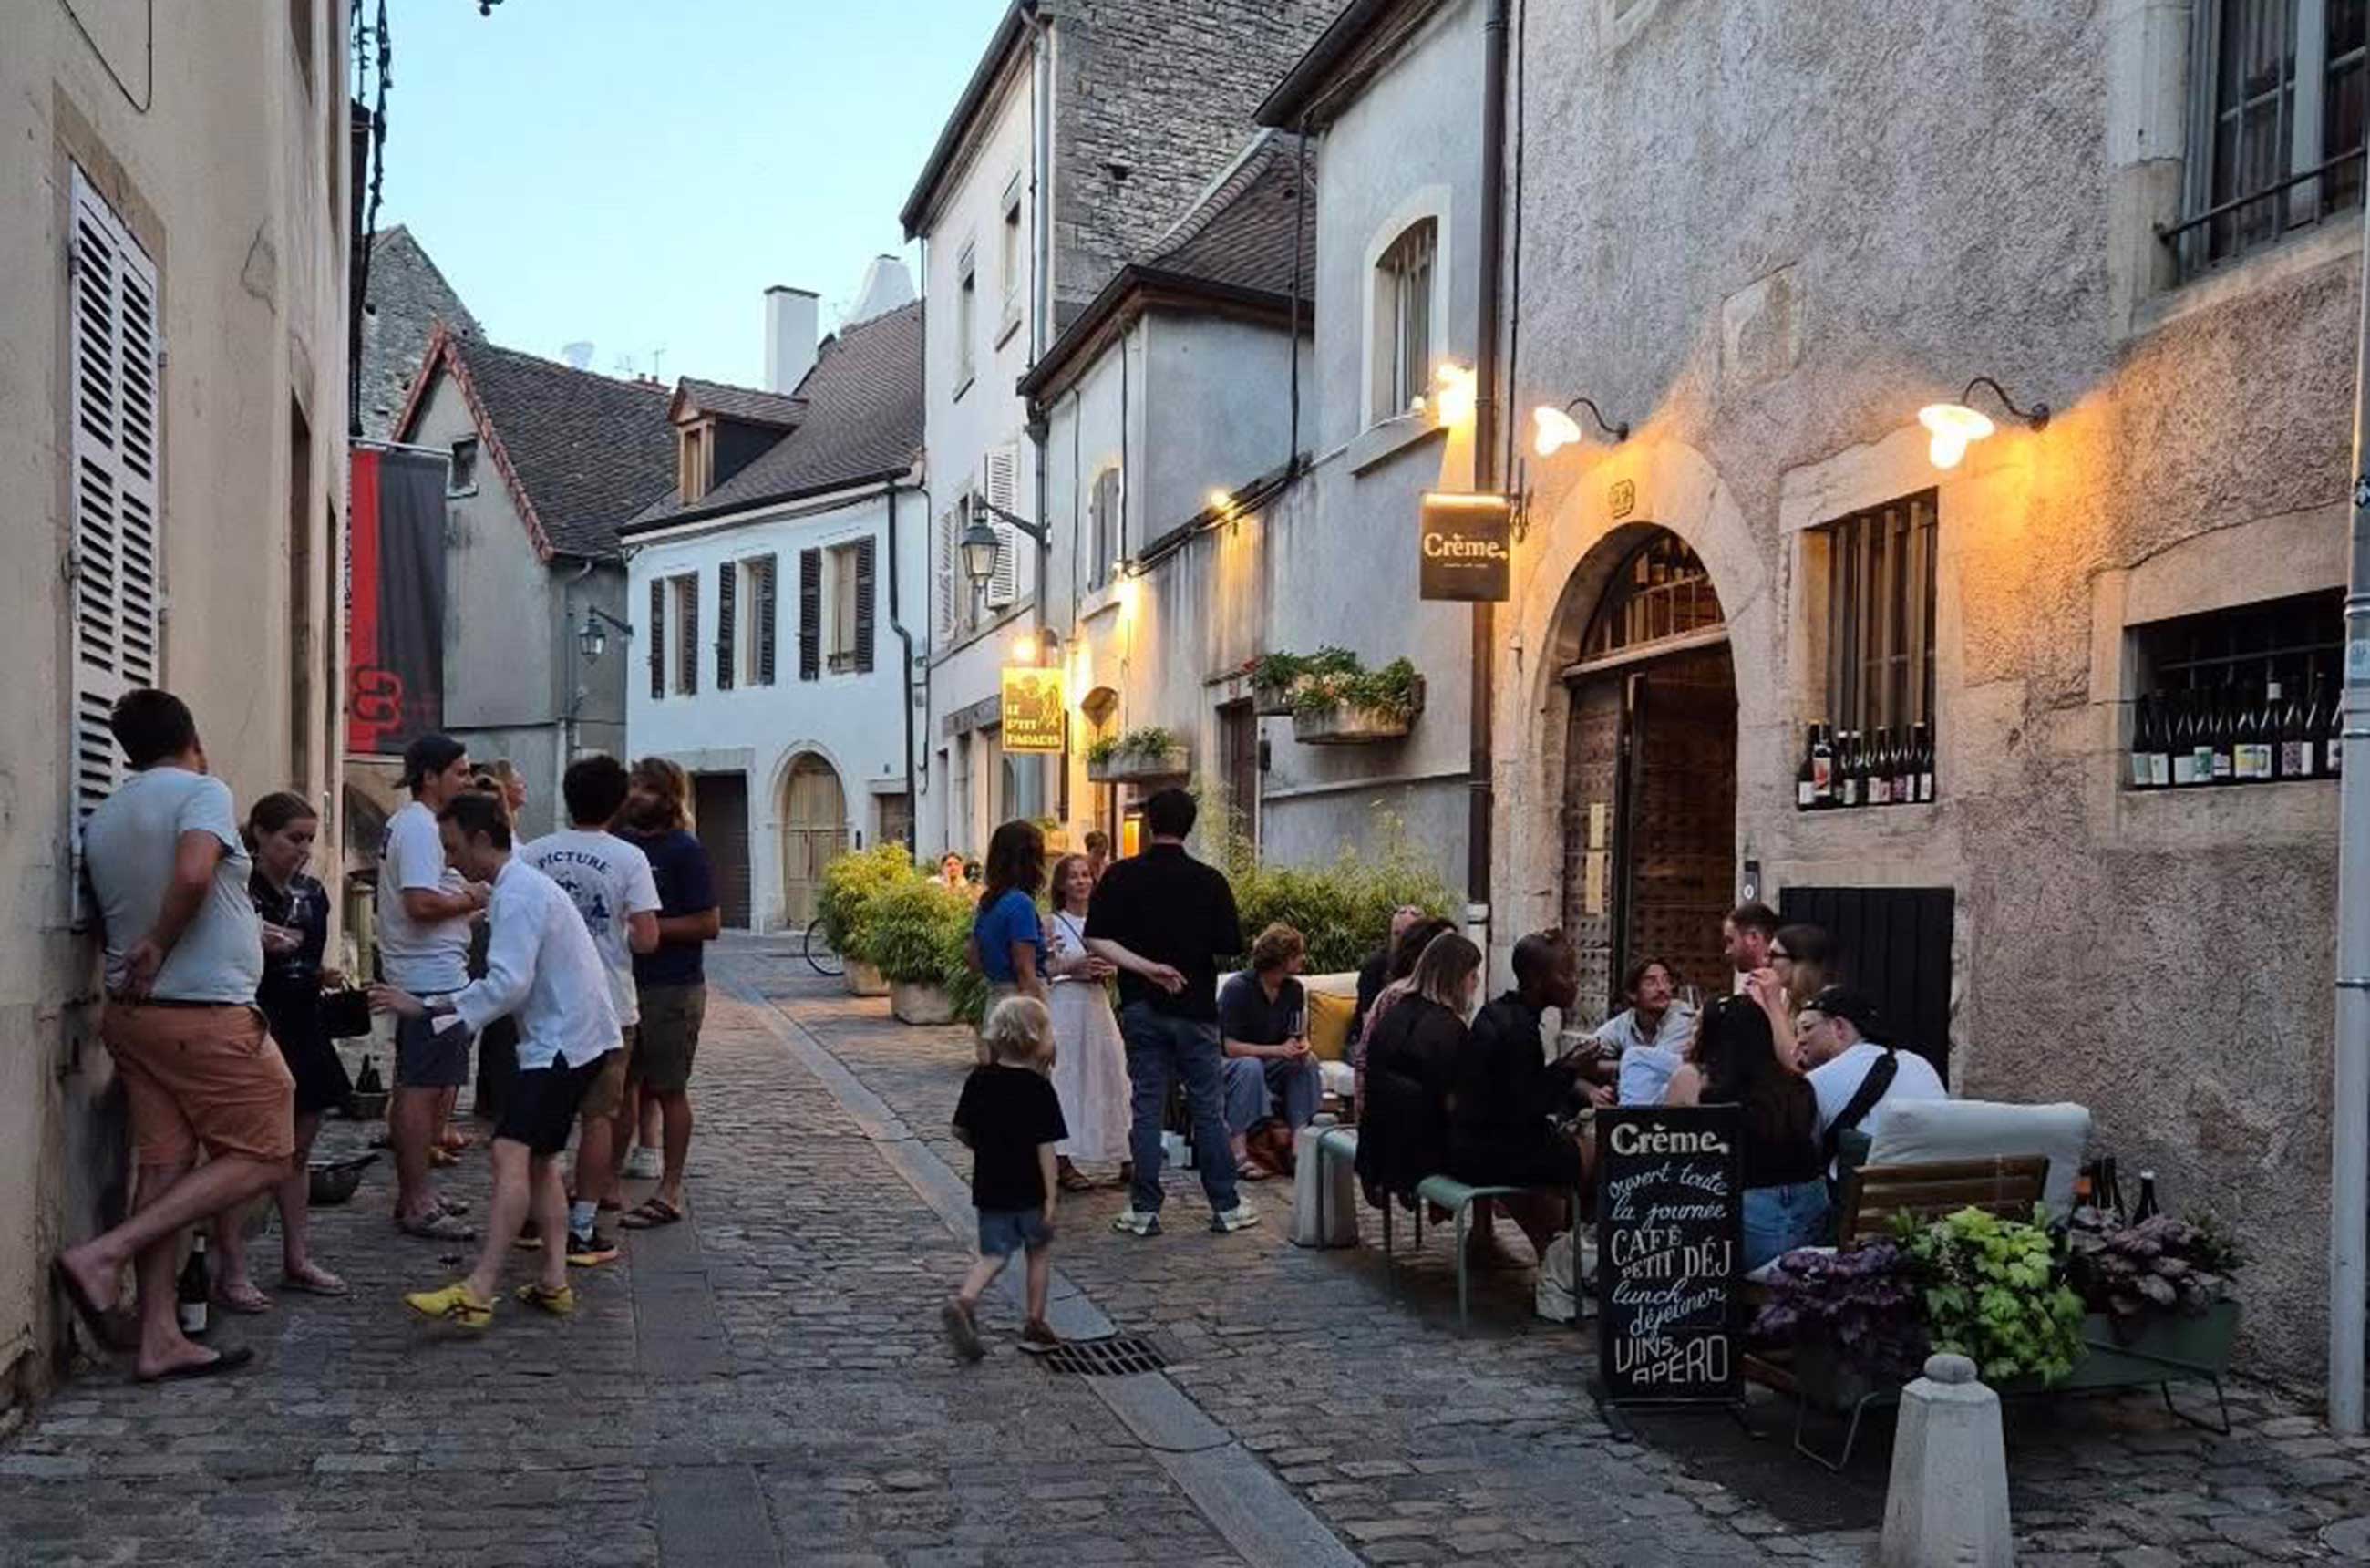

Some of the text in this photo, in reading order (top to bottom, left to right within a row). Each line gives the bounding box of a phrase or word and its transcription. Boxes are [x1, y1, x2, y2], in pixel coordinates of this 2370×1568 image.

[538, 851, 610, 874] PICTURE
[1608, 1161, 1727, 1199] ouvert toute
[1611, 1191, 1635, 1220] la
[1611, 1224, 1682, 1265] CAFÉ
[1621, 1235, 1732, 1277] PETIT DÉJ
[1611, 1277, 1688, 1305] lunch
[1629, 1287, 1727, 1344] déjeuner
